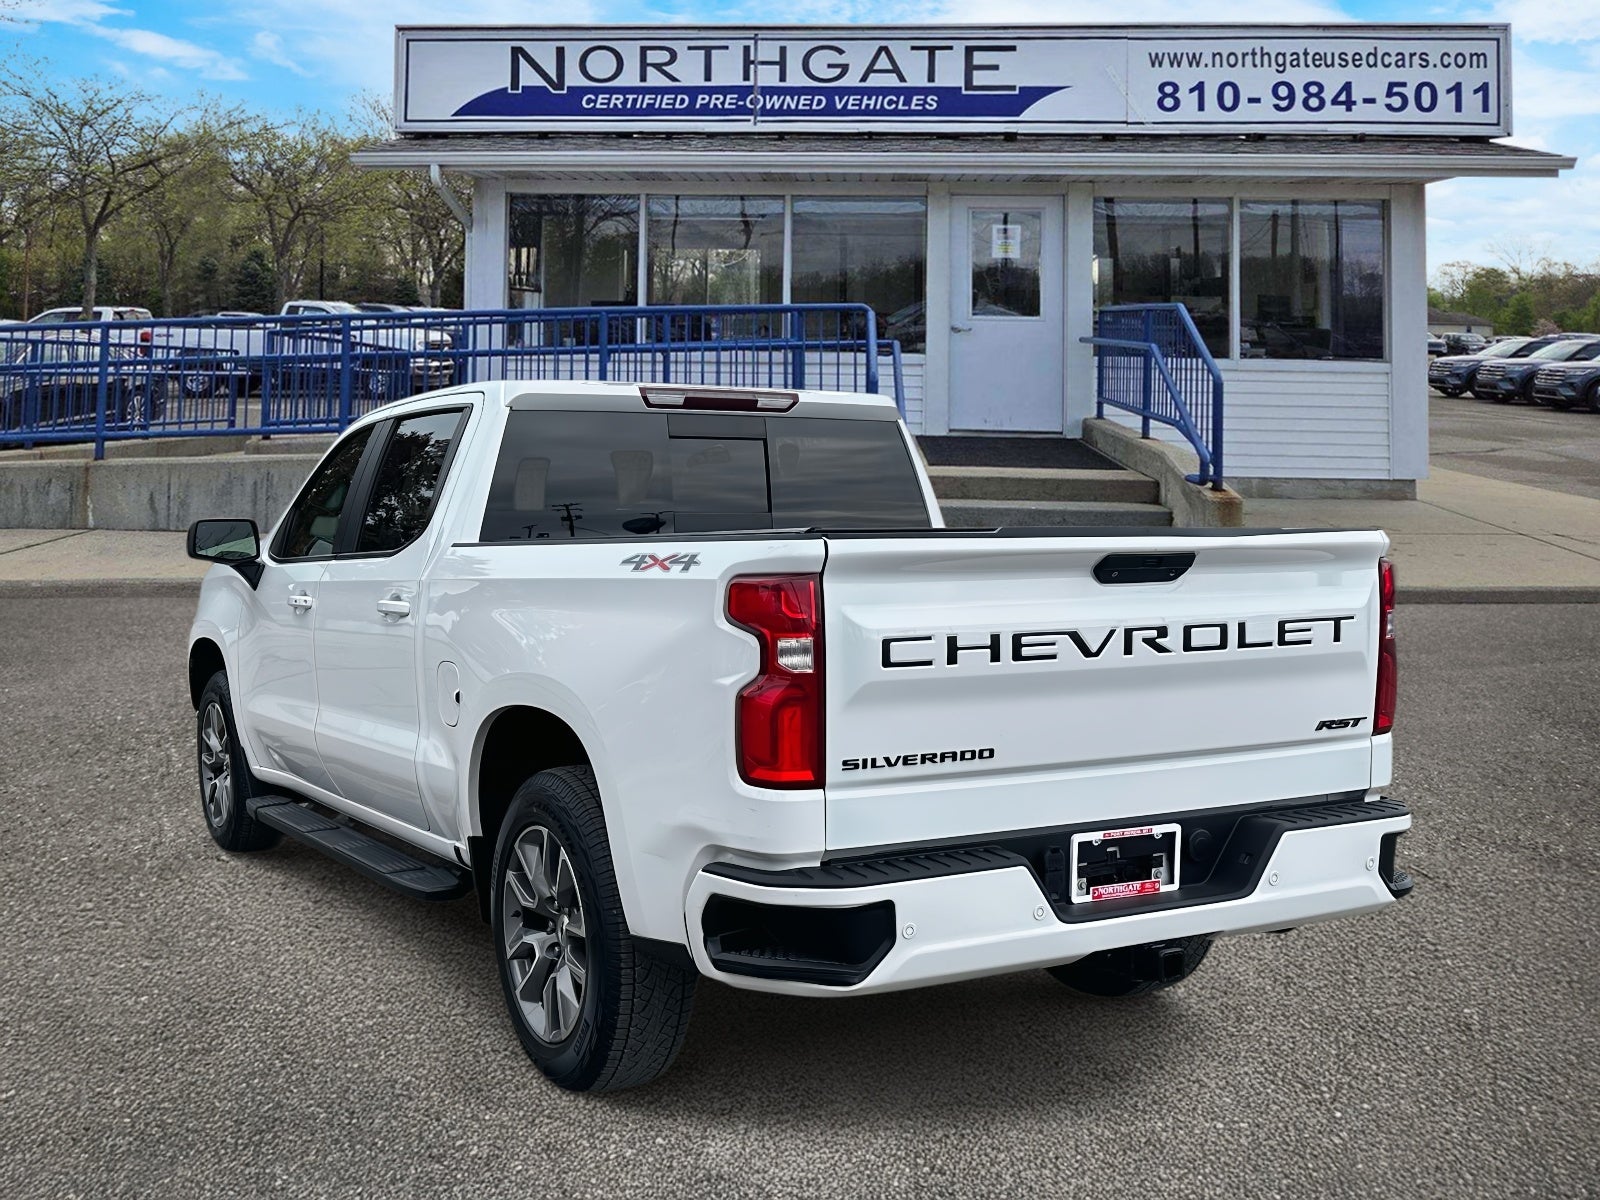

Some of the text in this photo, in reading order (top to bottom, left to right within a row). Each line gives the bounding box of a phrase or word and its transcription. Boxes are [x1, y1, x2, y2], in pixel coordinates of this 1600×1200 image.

[508, 44, 1018, 93] NORTHGATE
[1147, 46, 1489, 74] www.northgateusedcars.com
[580, 94, 939, 111] CERTIFIED PRE-OWNED VEHICLES
[1156, 80, 1492, 113] 810-984-5011
[880, 614, 1356, 670] CHEVROLET
[1314, 716, 1368, 731] RST
[841, 747, 995, 772] SILVERADO
[1099, 883, 1142, 895] NORTHGATE
